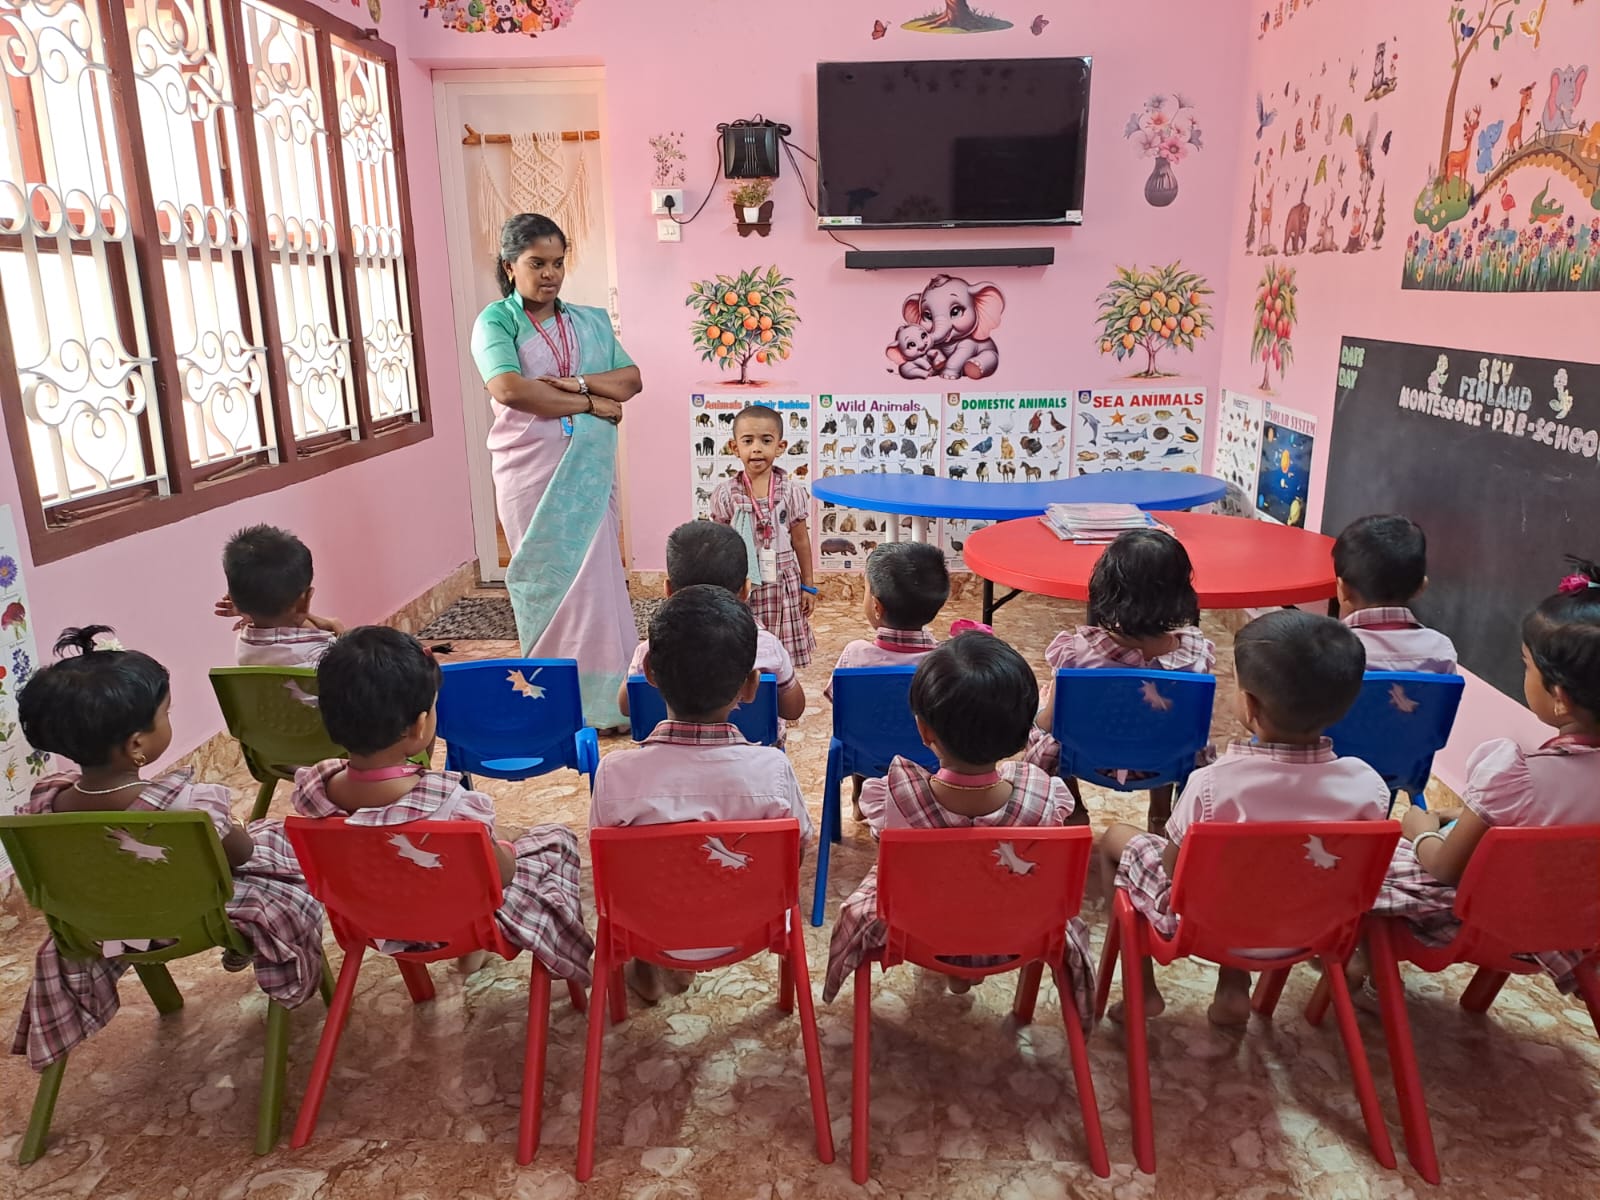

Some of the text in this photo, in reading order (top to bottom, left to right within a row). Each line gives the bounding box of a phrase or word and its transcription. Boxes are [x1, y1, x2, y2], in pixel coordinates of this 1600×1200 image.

[1341, 345, 1365, 368] DATE
[1338, 367, 1358, 389] DAY
[961, 399, 1015, 410] DOMESTIC
[1018, 397, 1067, 409] ANIMALS
[1093, 395, 1124, 408] SEA
[1129, 393, 1204, 406] ANIMALS
[1459, 375, 1532, 411] FINLAND
[704, 400, 742, 409] Animals
[778, 400, 810, 409] Babies
[836, 400, 866, 412] Wild
[870, 400, 921, 412] Animals
[1270, 410, 1316, 435] SOLAR SYSTEM
[1399, 385, 1483, 426] MONTESSORI
[1492, 408, 1600, 461] PRE-SCHOO
